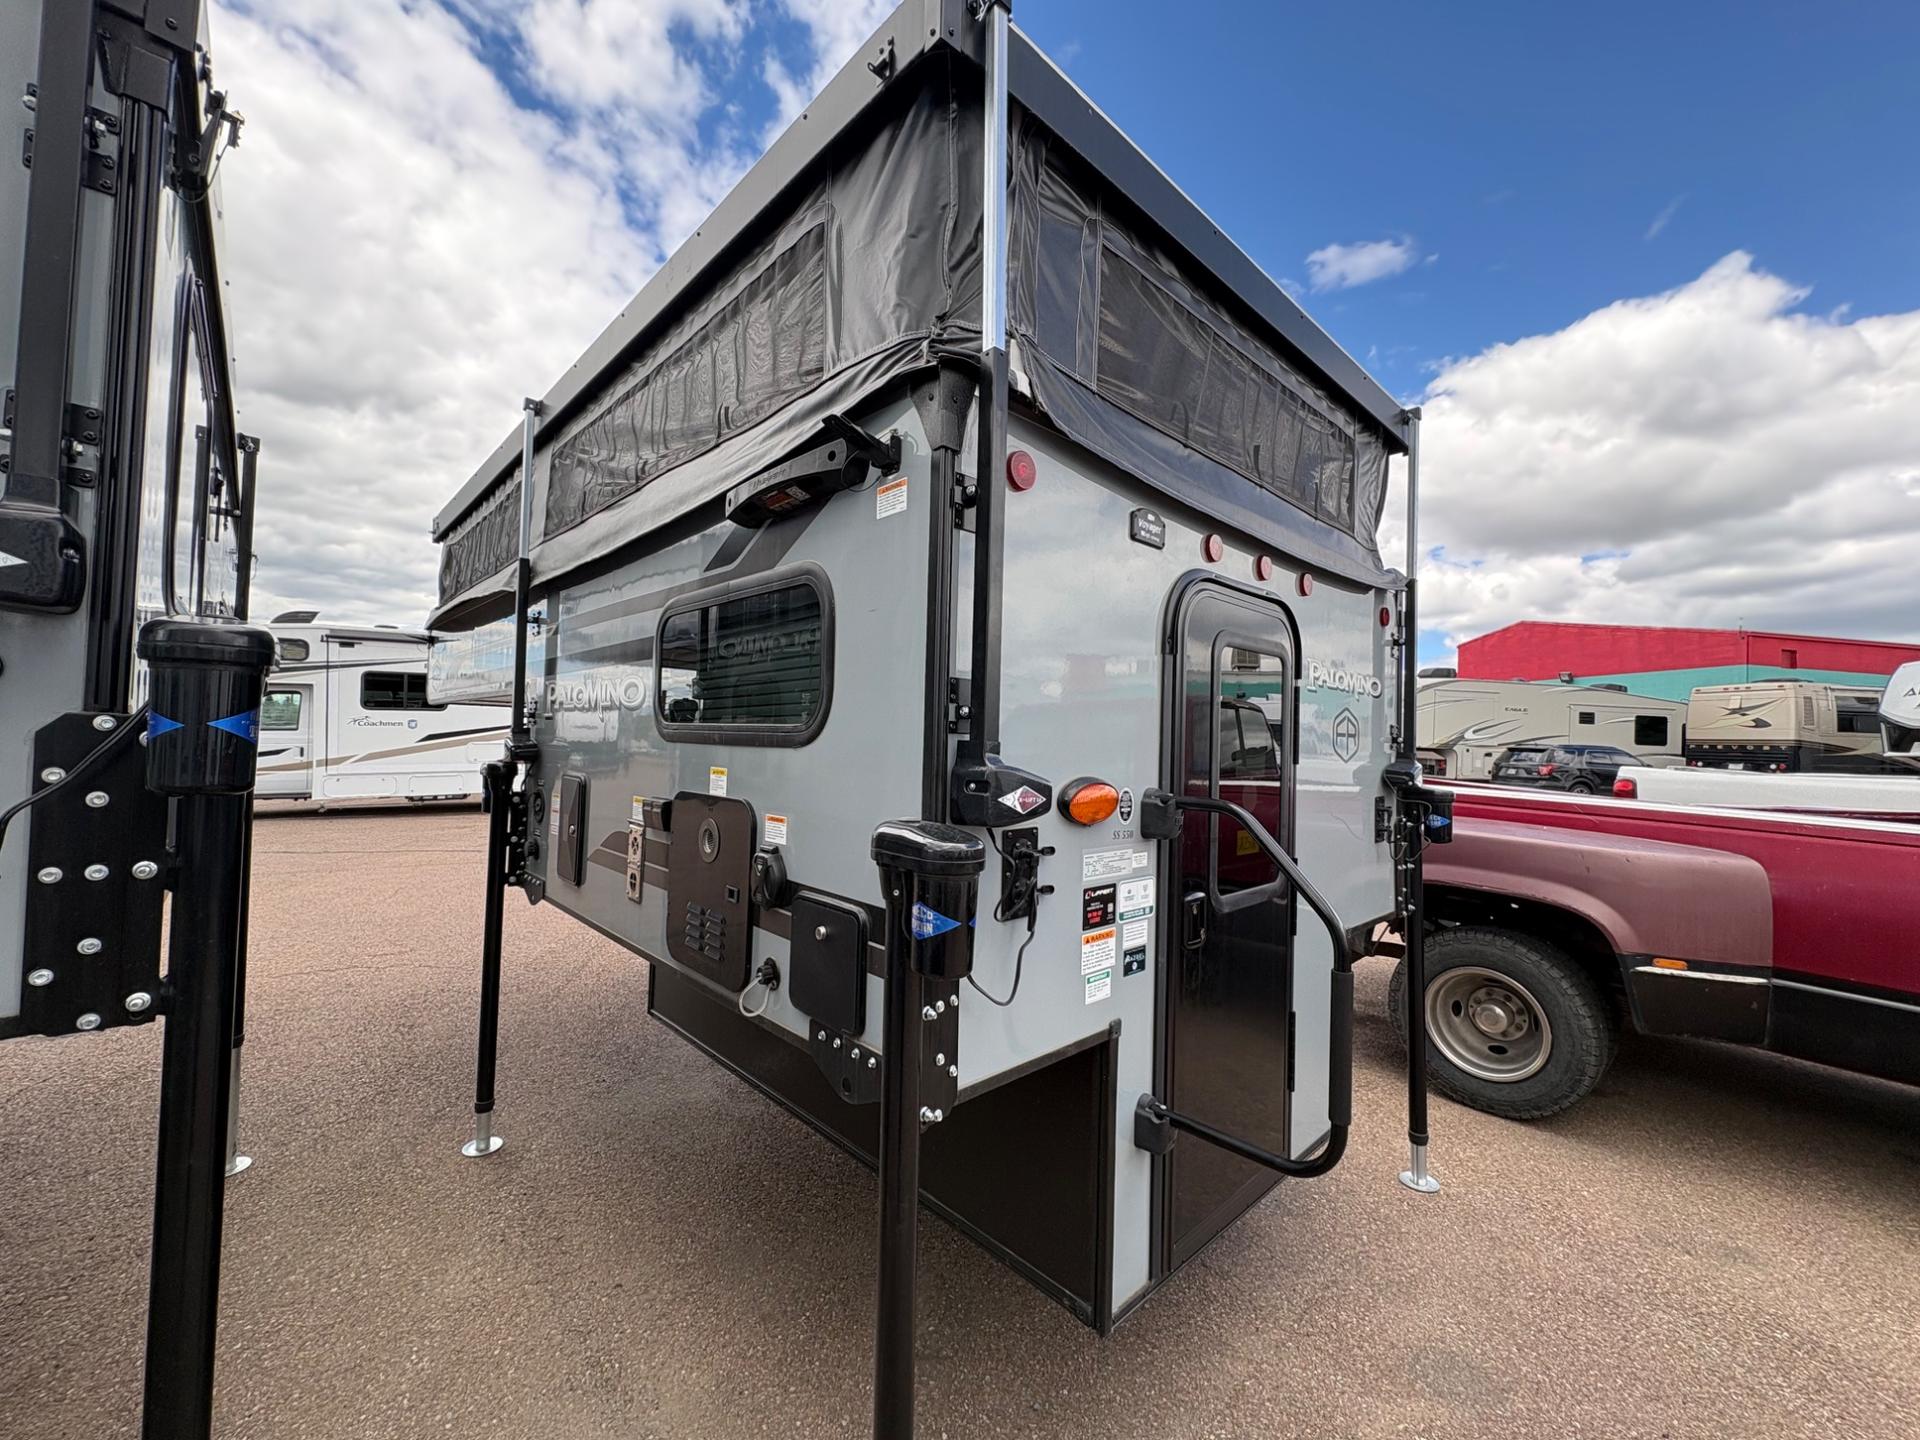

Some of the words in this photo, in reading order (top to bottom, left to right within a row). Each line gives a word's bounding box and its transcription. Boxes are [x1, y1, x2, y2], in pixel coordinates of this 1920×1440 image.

[1138, 518, 1161, 534] Voyager
[1307, 658, 1382, 702] PALOMINO
[544, 676, 646, 723] PALOMINO
[357, 719, 404, 727] Coachmen
[1112, 830, 1121, 840] SS
